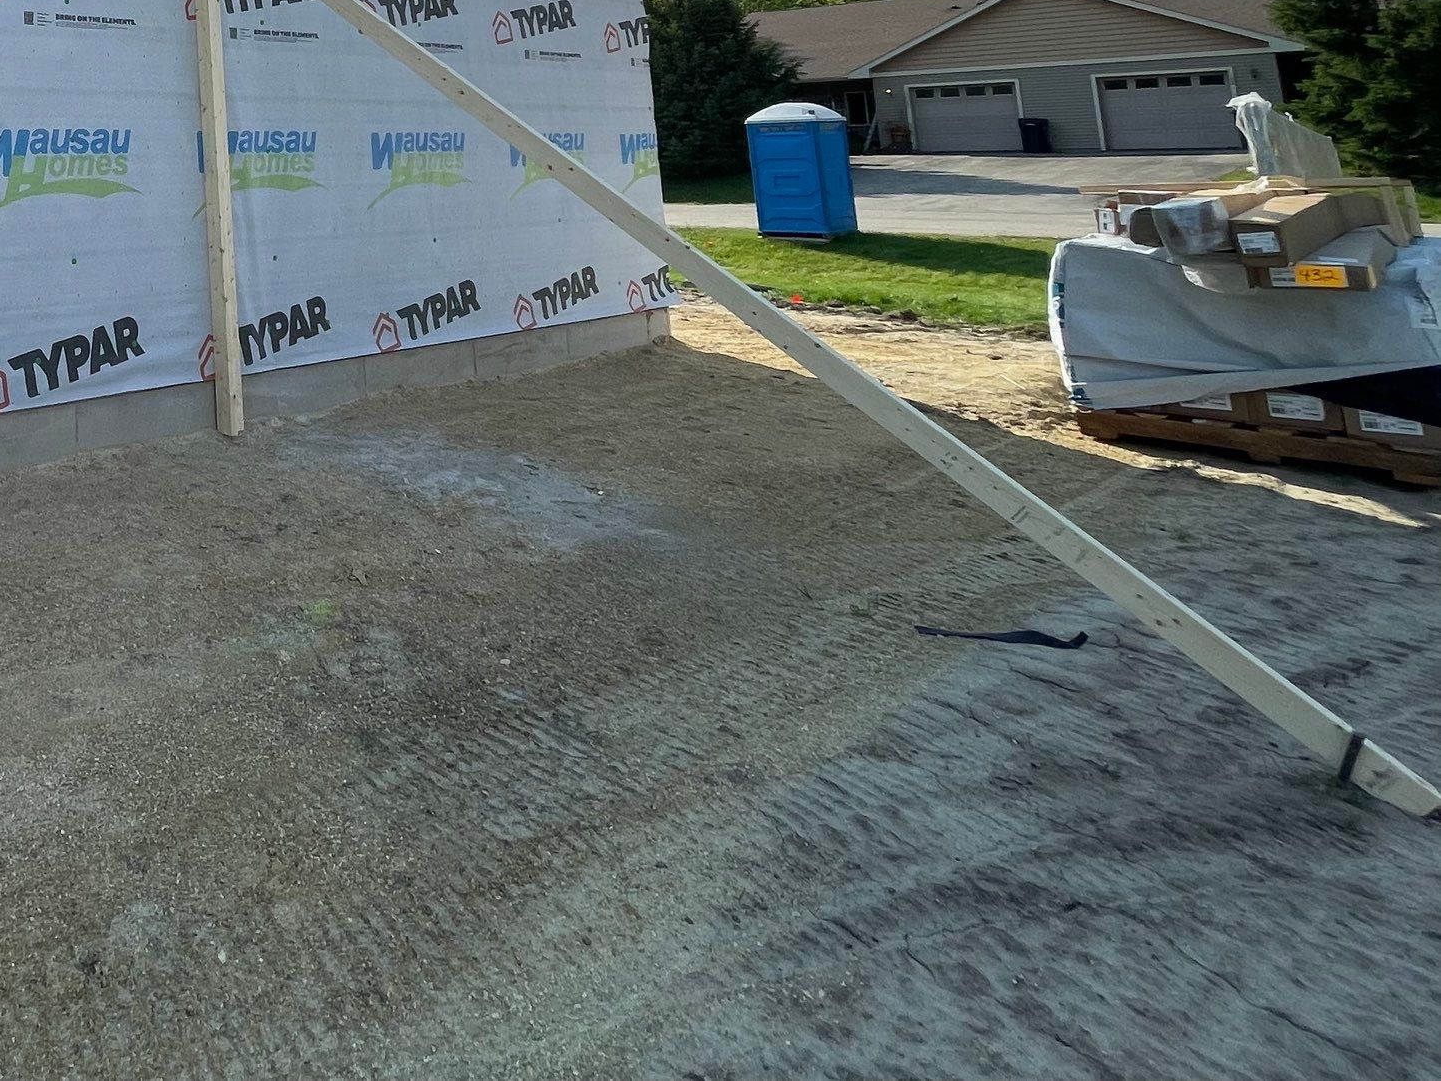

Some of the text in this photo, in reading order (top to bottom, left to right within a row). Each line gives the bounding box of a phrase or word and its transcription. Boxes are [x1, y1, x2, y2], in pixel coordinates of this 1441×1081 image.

[510, 0, 576, 39] TYPAR
[618, 17, 650, 47] TYP
[371, 132, 465, 169] Wausau
[619, 133, 655, 164] Wau
[8, 154, 130, 193] Homes
[532, 266, 600, 319] TYPAR
[641, 264, 674, 302] TYP
[1299, 268, 1339, 282] 432
[396, 279, 481, 340] TYPAR
[237, 295, 331, 366] TYPAR
[7, 316, 146, 398] TYPAR
